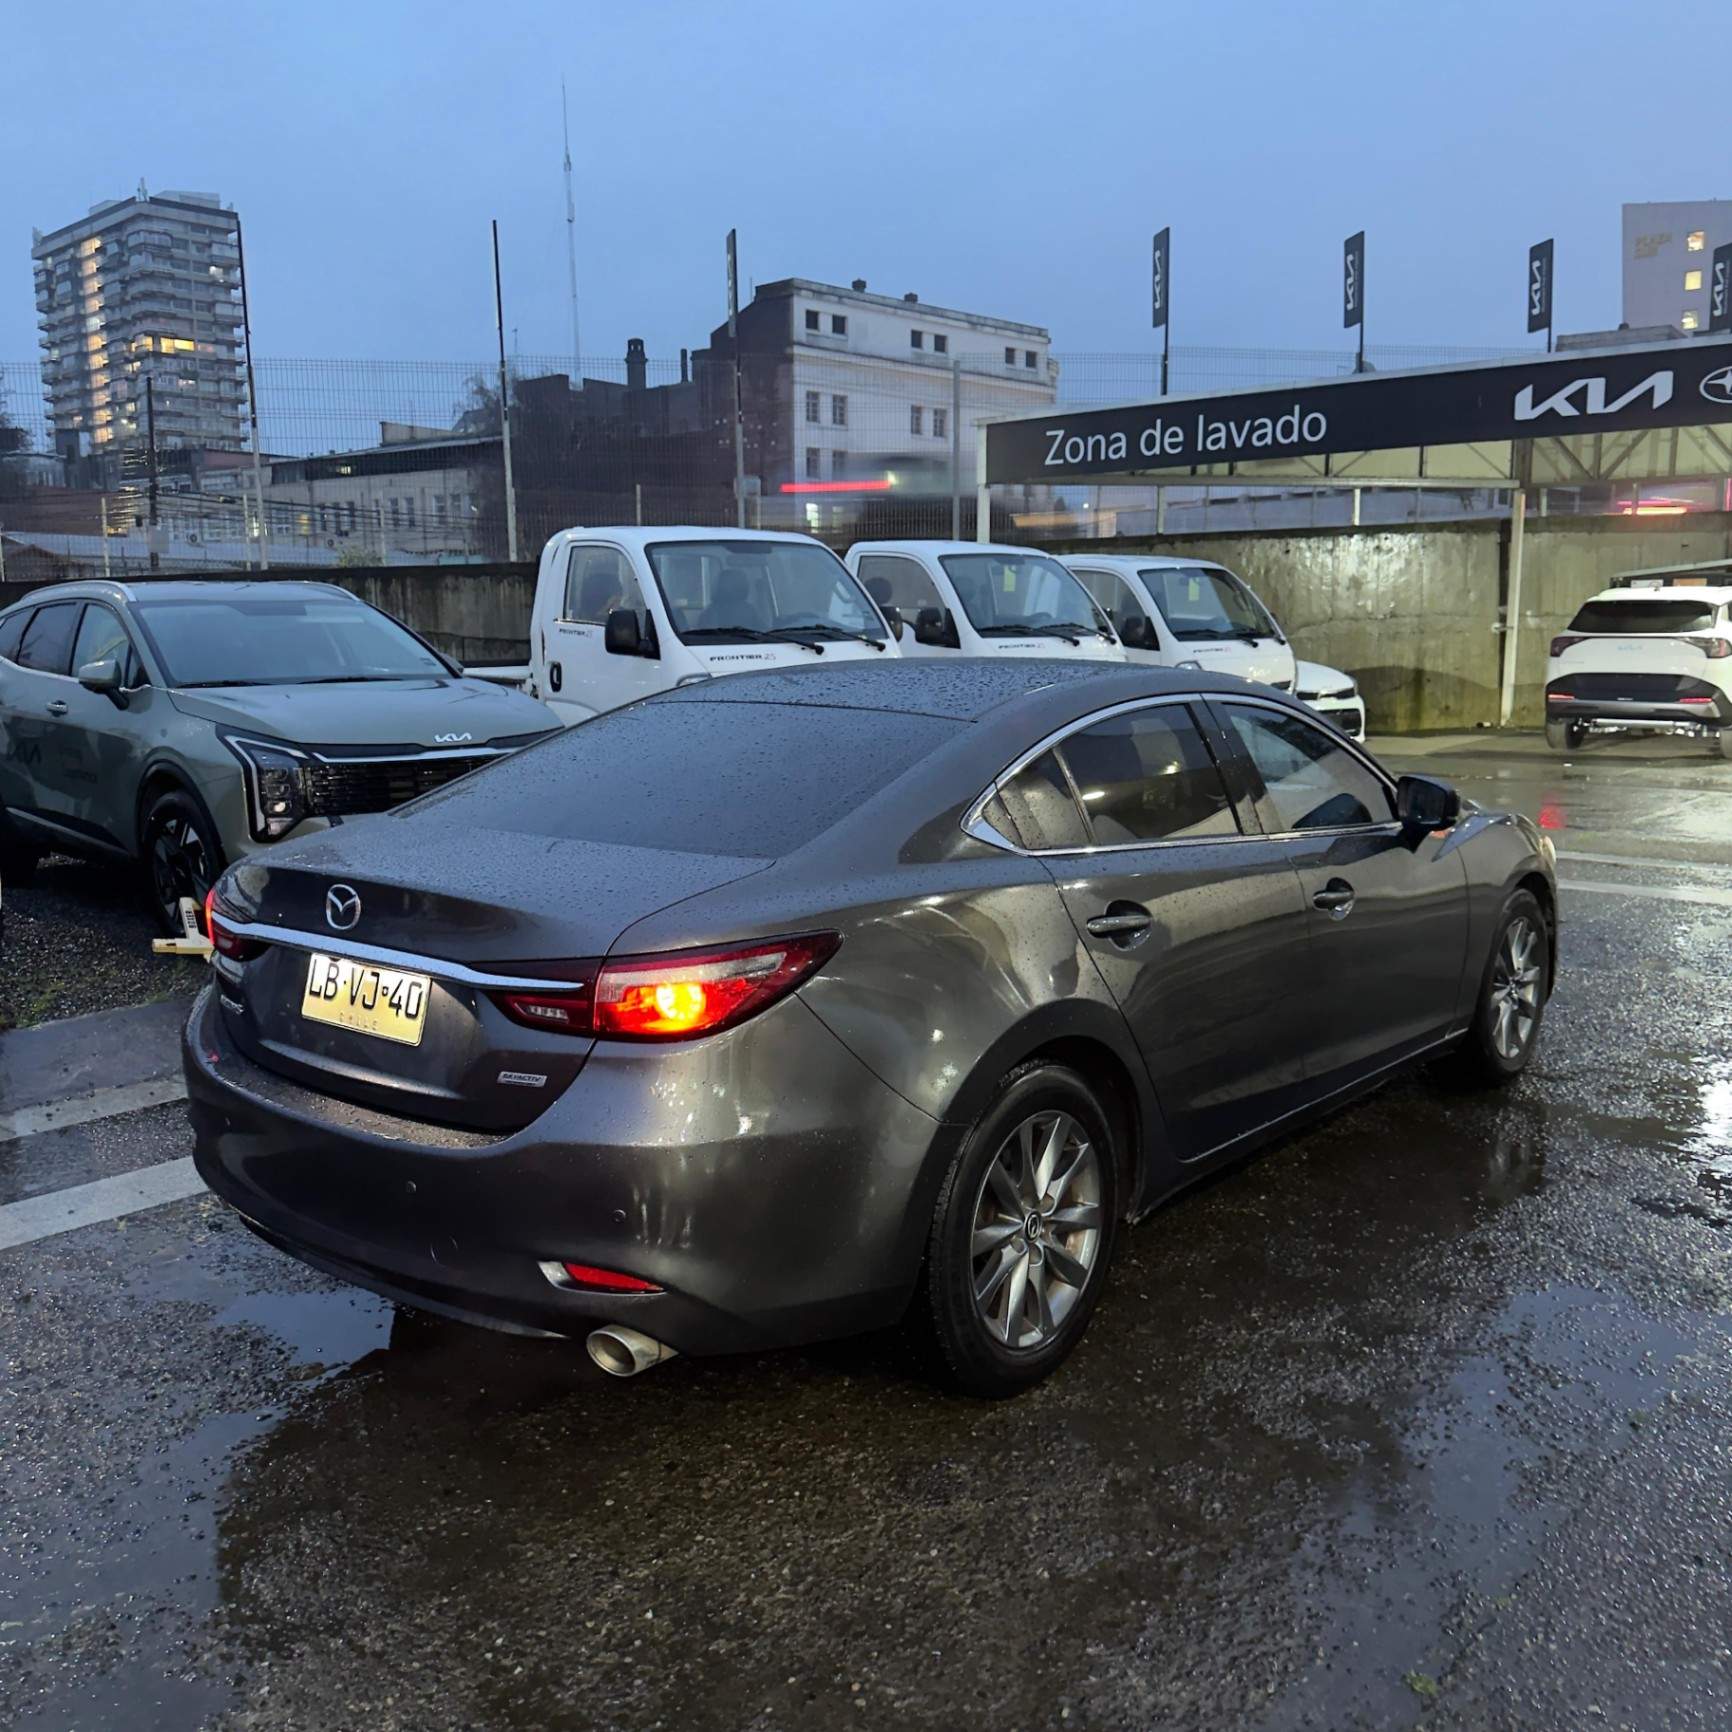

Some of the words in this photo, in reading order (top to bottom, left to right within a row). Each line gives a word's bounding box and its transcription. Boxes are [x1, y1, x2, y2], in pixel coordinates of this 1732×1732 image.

[1346, 254, 1354, 311] KIA
[1531, 260, 1541, 316] KIA
[1713, 262, 1725, 317] KIA
[1514, 370, 1674, 421] KIA
[1045, 429, 1127, 465] Zona
[1140, 418, 1184, 456] de
[1197, 404, 1327, 452] lavado
[709, 654, 762, 662] FRONTIER
[434, 732, 472, 743] KIA
